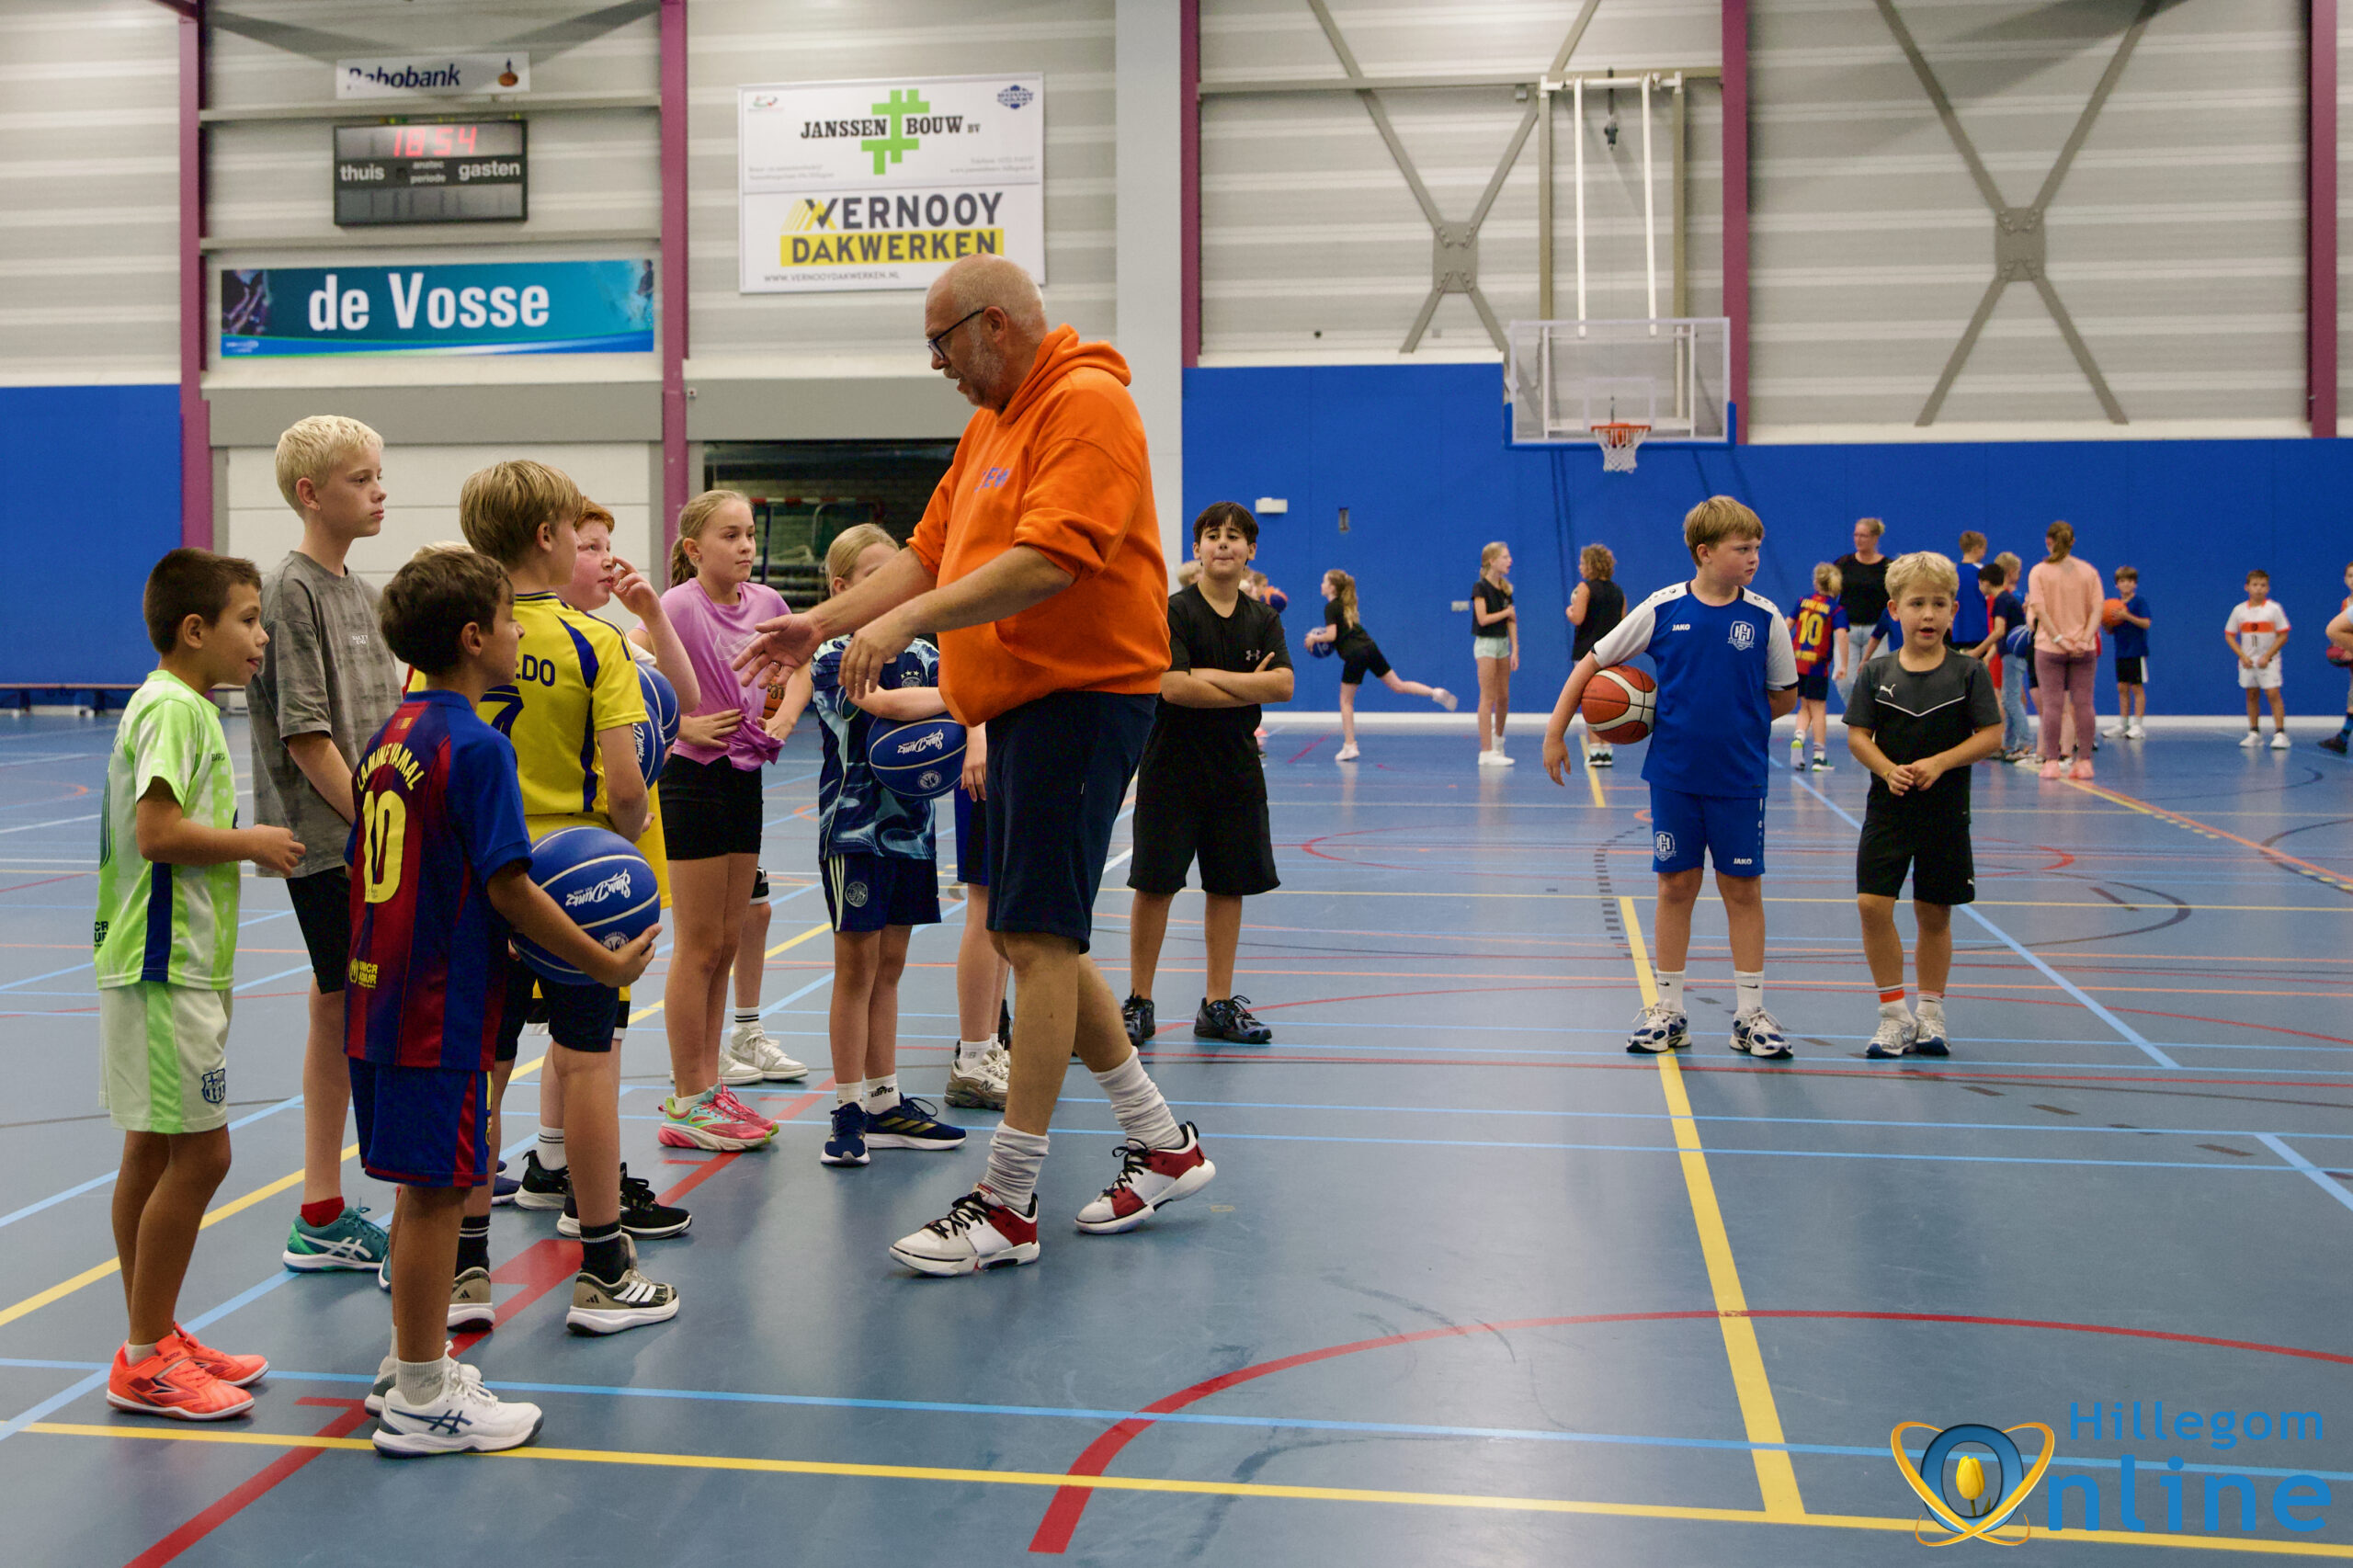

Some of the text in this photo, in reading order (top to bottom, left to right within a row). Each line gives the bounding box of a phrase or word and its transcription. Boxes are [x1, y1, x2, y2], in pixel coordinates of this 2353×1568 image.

[801, 119, 887, 139] JANSSEN
[905, 116, 963, 134] BOUW
[340, 165, 385, 181] thuis
[459, 160, 520, 181] gasten
[805, 192, 1003, 230] VERNOOY
[791, 232, 995, 264] DAKWERKEN
[308, 272, 550, 332] de Vosse
[1799, 610, 1824, 646] 10
[516, 654, 556, 687] DO
[479, 685, 525, 741] 7
[362, 790, 406, 903] 10
[565, 869, 631, 907] Slam Dunkz
